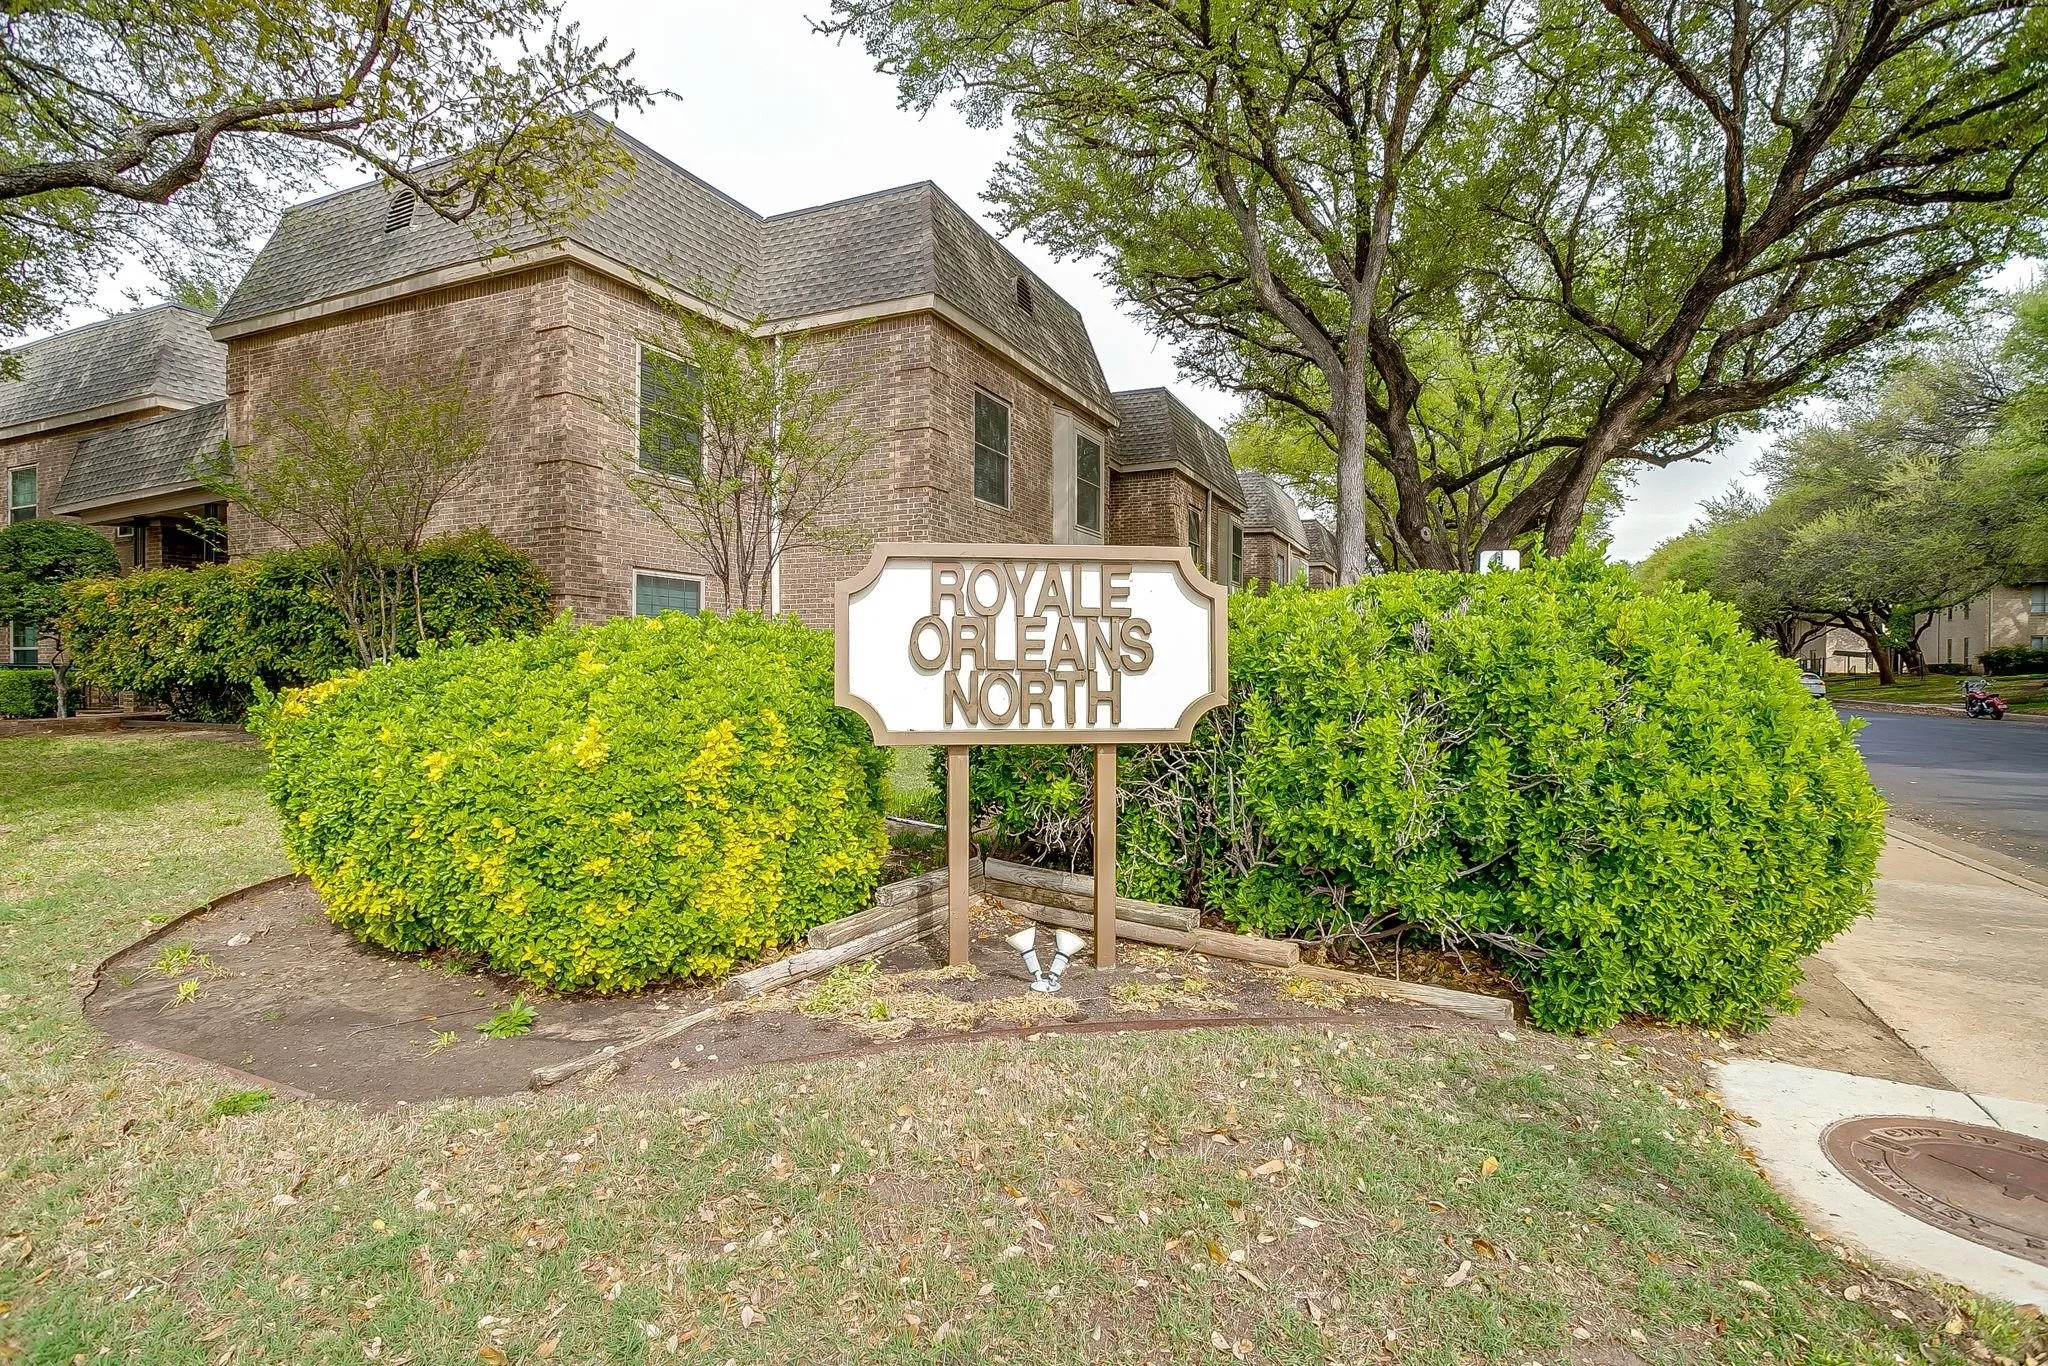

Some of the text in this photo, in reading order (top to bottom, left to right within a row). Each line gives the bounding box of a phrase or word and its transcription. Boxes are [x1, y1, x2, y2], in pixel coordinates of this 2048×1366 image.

[931, 562, 1132, 617] ROYALE
[909, 615, 1154, 671] ORLEANS
[943, 669, 1122, 725] NORTH
[1884, 1127, 2000, 1146] CITY OF
